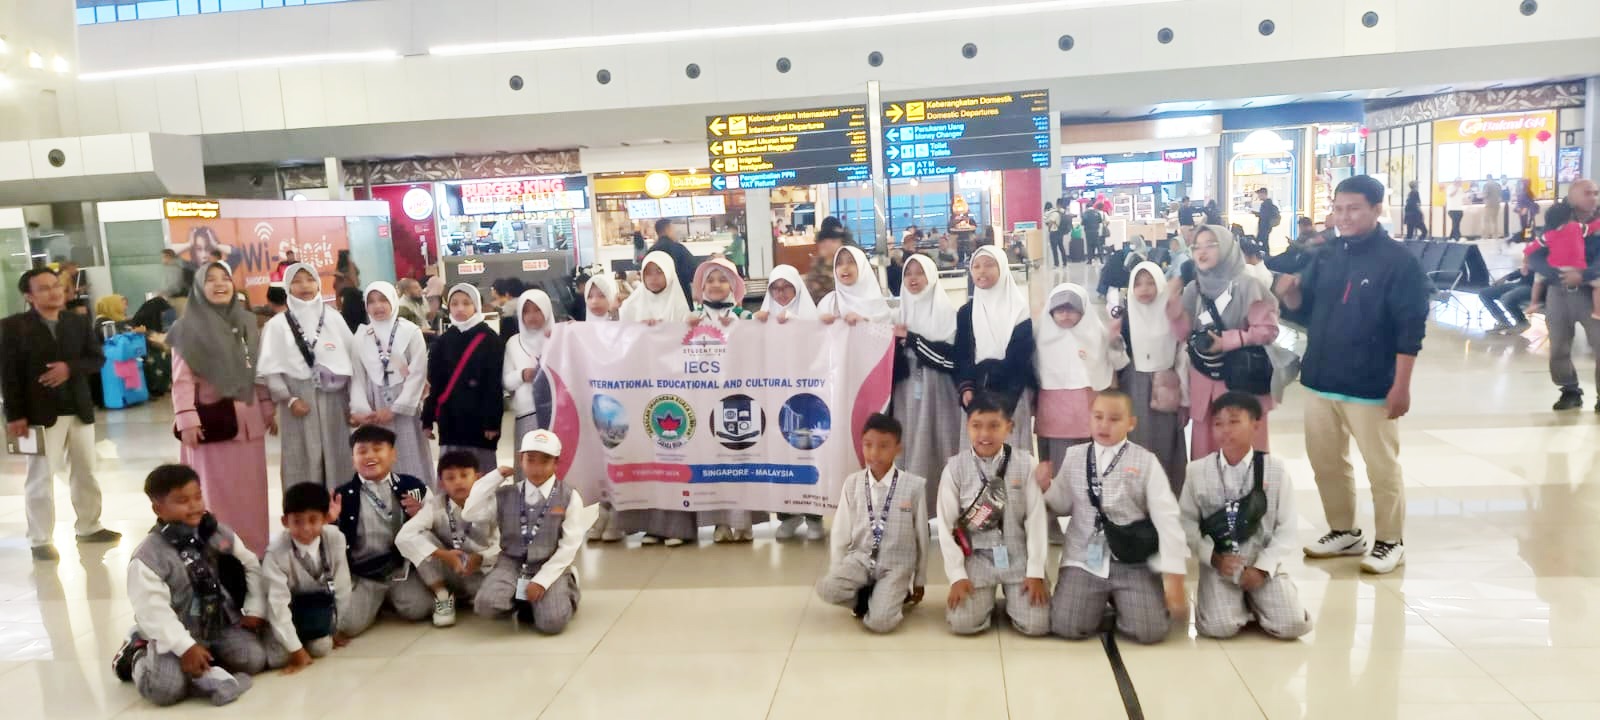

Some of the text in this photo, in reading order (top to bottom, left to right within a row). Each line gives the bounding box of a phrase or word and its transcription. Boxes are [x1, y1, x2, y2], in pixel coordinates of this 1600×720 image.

[927, 98, 978, 109] Keberangkatan
[980, 95, 1013, 105] Domestik
[748, 112, 796, 122] Keberangkatan
[797, 109, 839, 119] Internasional
[927, 108, 999, 120] Domestic Departures
[748, 122, 825, 134] International Departures
[915, 123, 965, 133] Penukaran Uang
[915, 130, 963, 140] Money Changer
[936, 166, 957, 174] Center
[461, 179, 564, 197] BURGER KING
[684, 361, 720, 374] IECS
[657, 379, 719, 389] EDUCATIONAL
[723, 379, 742, 389] AND
[745, 378, 792, 388] CULTURAL
[796, 378, 825, 388] STUDY
[703, 469, 748, 477] SINGAPORE
